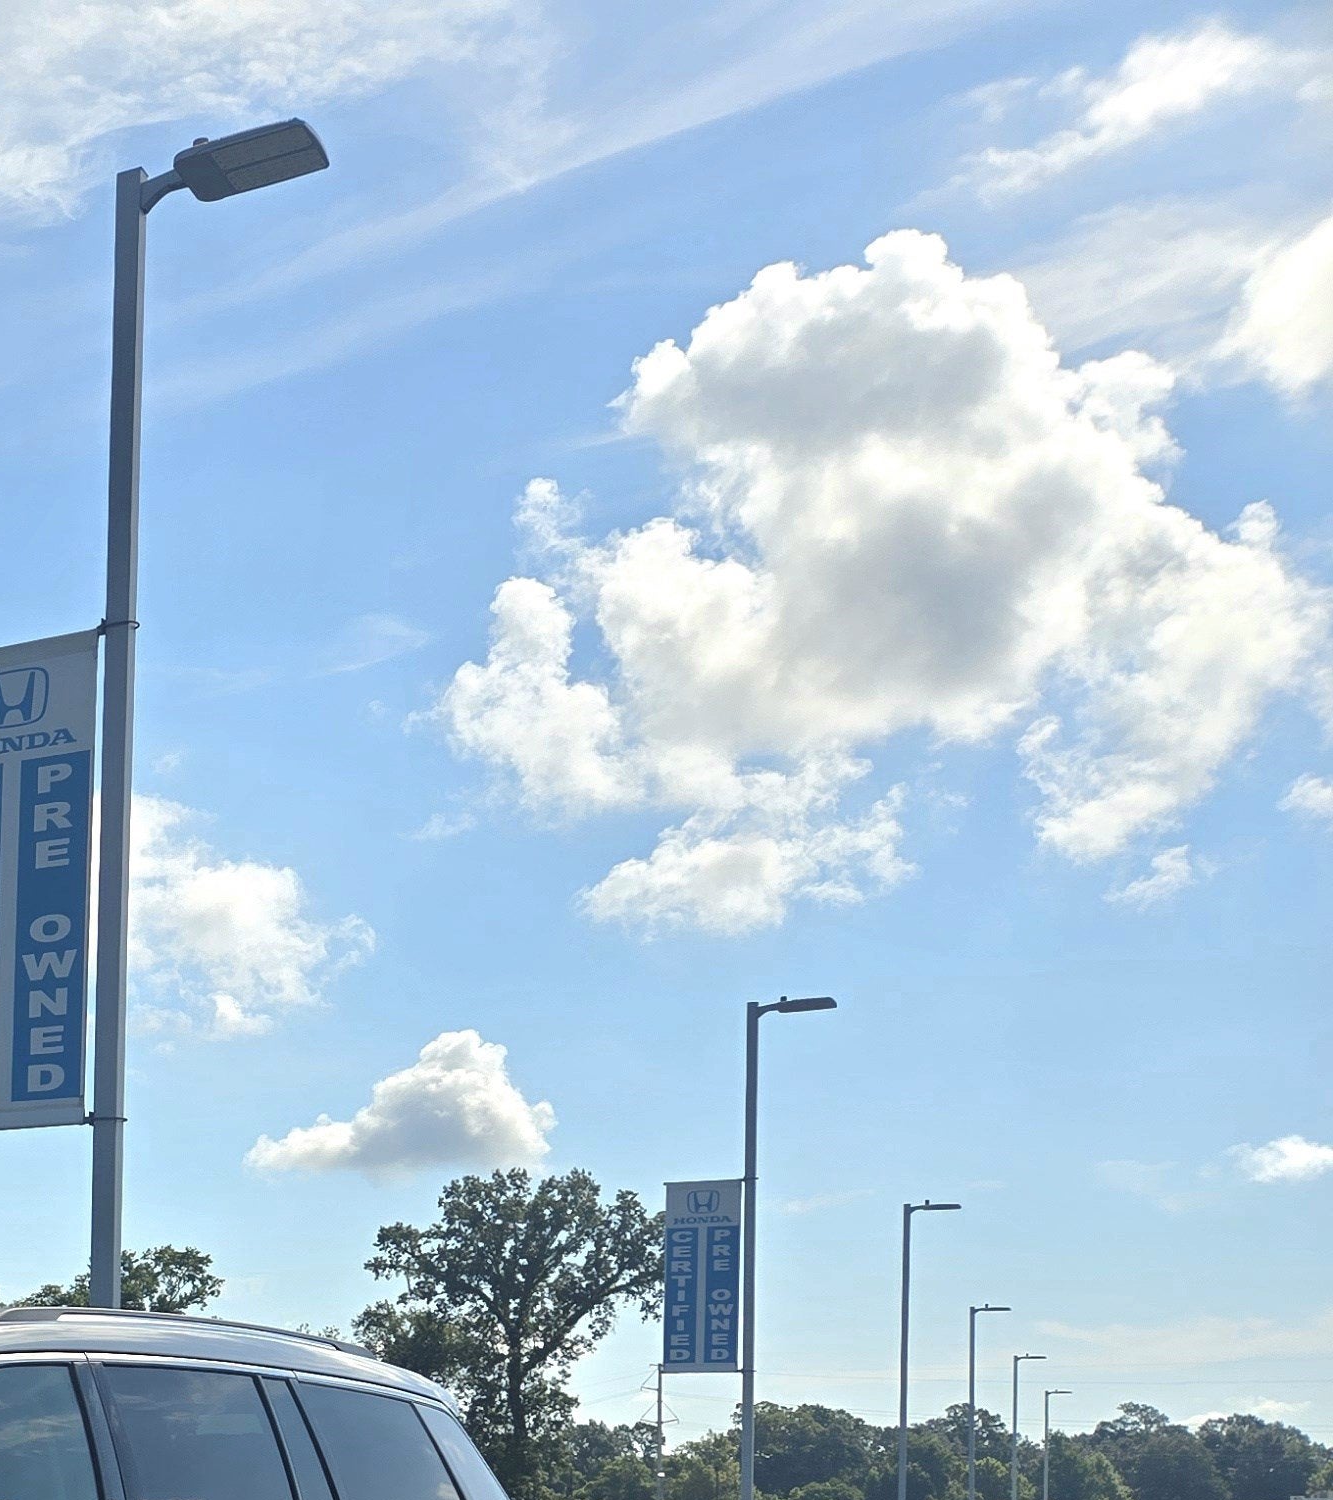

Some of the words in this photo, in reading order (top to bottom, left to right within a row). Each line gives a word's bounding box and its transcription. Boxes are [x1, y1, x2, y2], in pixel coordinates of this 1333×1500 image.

[33, 763, 74, 870] PRE
[22, 913, 78, 1094] OWNED
[673, 1215, 732, 1225] HONDA
[712, 1229, 731, 1272] PRE
[668, 1230, 694, 1361] CERTIFIED
[707, 1288, 734, 1361] OWNED
